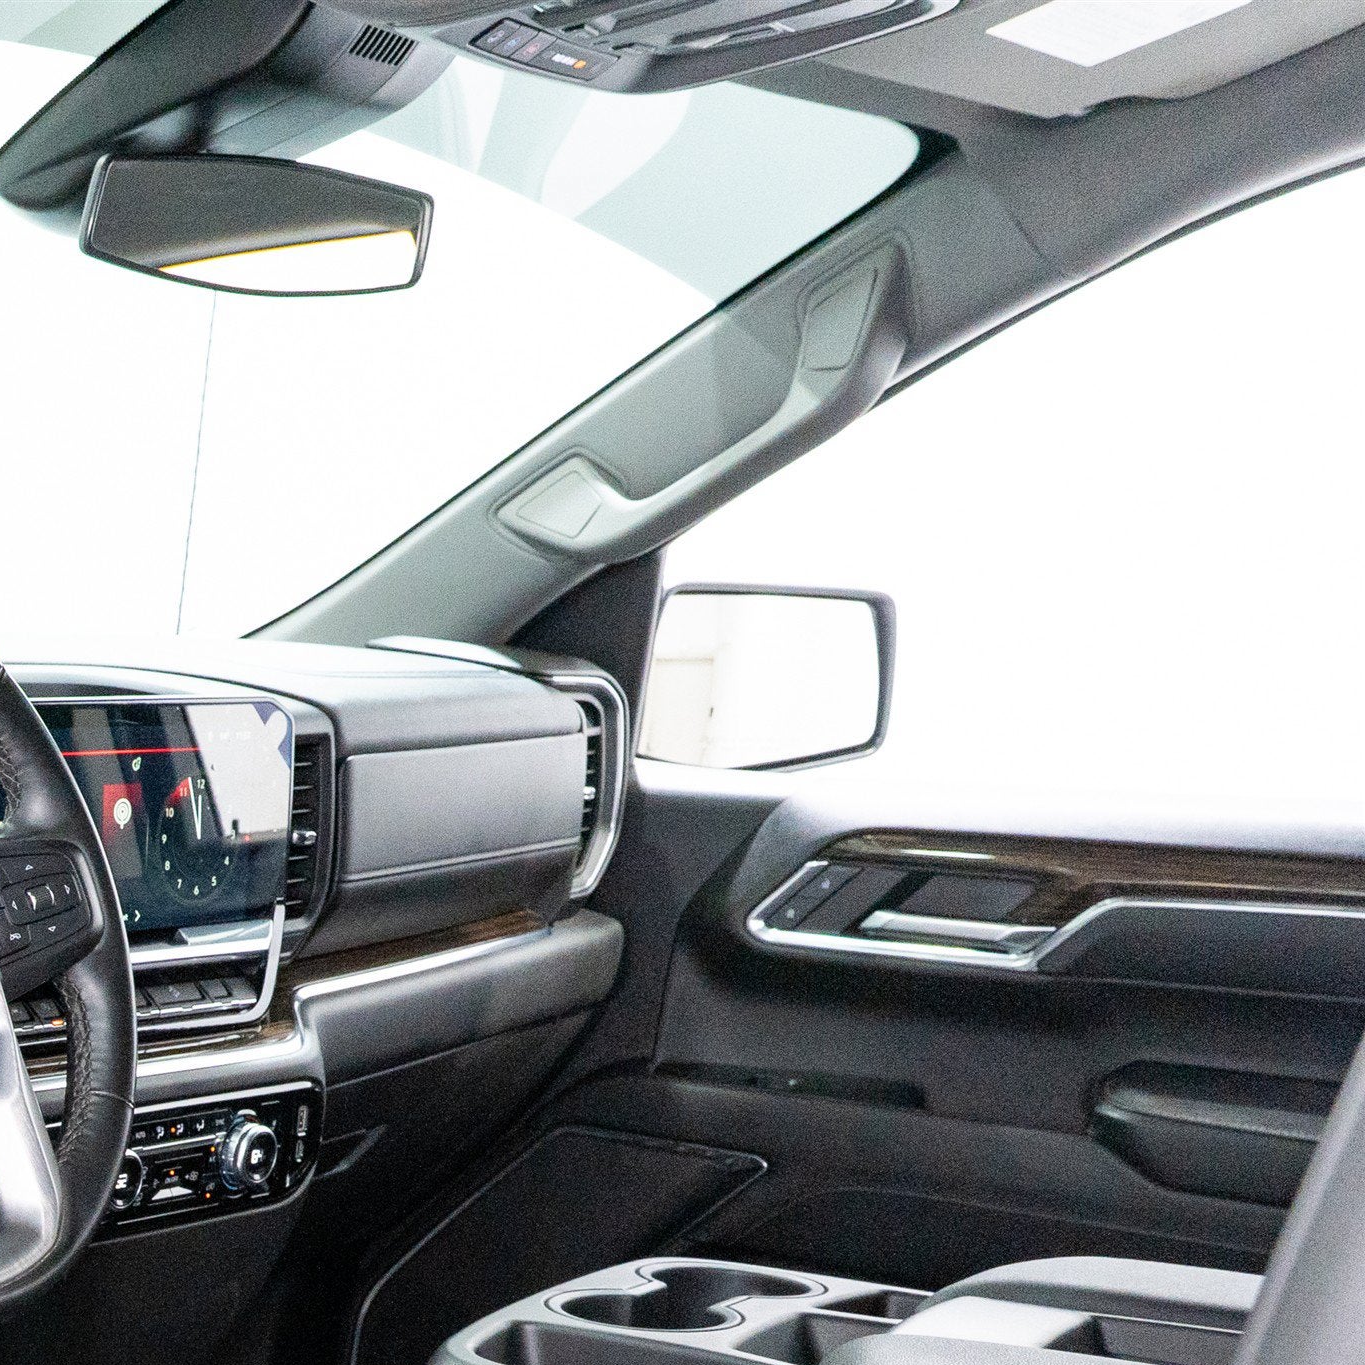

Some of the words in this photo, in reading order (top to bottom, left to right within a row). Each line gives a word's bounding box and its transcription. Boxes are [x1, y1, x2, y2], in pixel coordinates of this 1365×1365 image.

[197, 779, 206, 789] 12
[165, 807, 174, 818] 10
[162, 834, 167, 844] 9
[164, 860, 170, 870] 8
[211, 876, 217, 886] 5
[194, 885, 200, 895] 6
